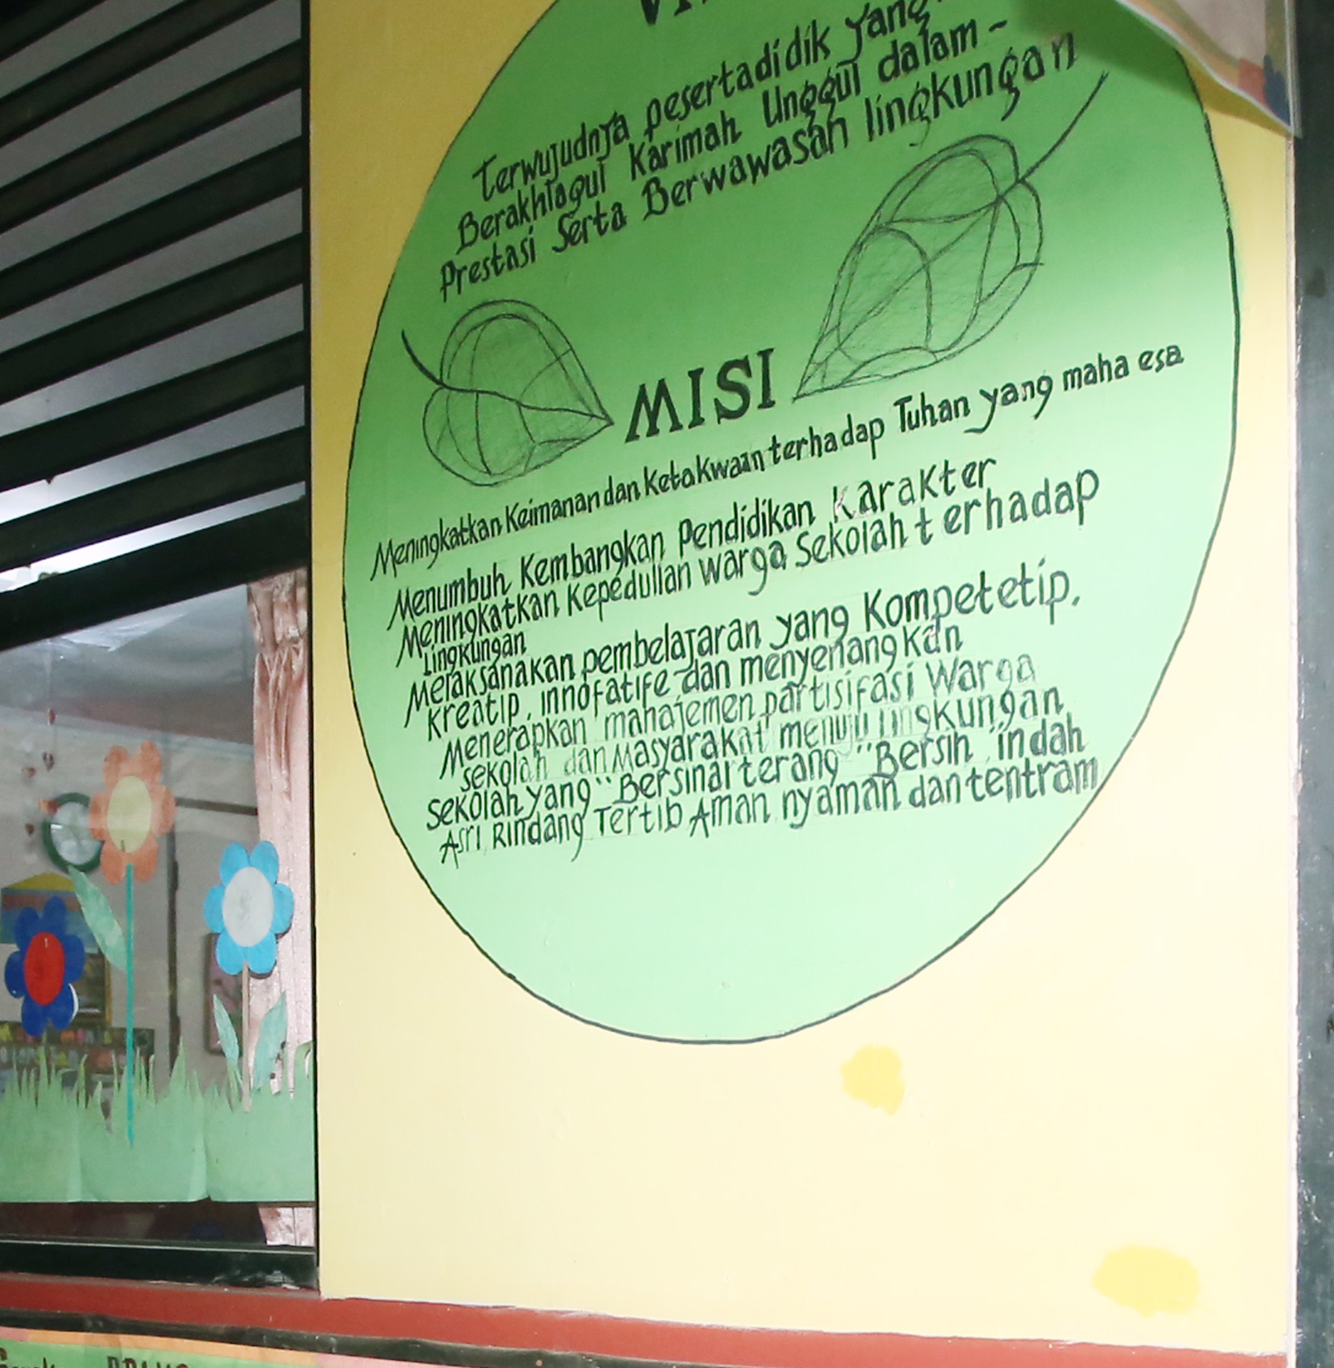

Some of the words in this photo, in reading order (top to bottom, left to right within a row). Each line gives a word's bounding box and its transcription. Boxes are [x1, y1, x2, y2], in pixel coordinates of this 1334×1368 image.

[625, 348, 776, 443] MISI
[370, 512, 503, 581] Meningkatkan
[604, 475, 642, 505] dan
[768, 414, 885, 467] terhadap
[893, 393, 971, 433] Tuhan
[964, 374, 1054, 434] yang
[1062, 353, 1130, 391] maha
[1137, 344, 1185, 373] esa
[770, 604, 849, 650] yang
[682, 654, 731, 695] dan
[526, 778, 591, 821] yang
[738, 748, 839, 788] terang
[908, 771, 961, 809] dan
